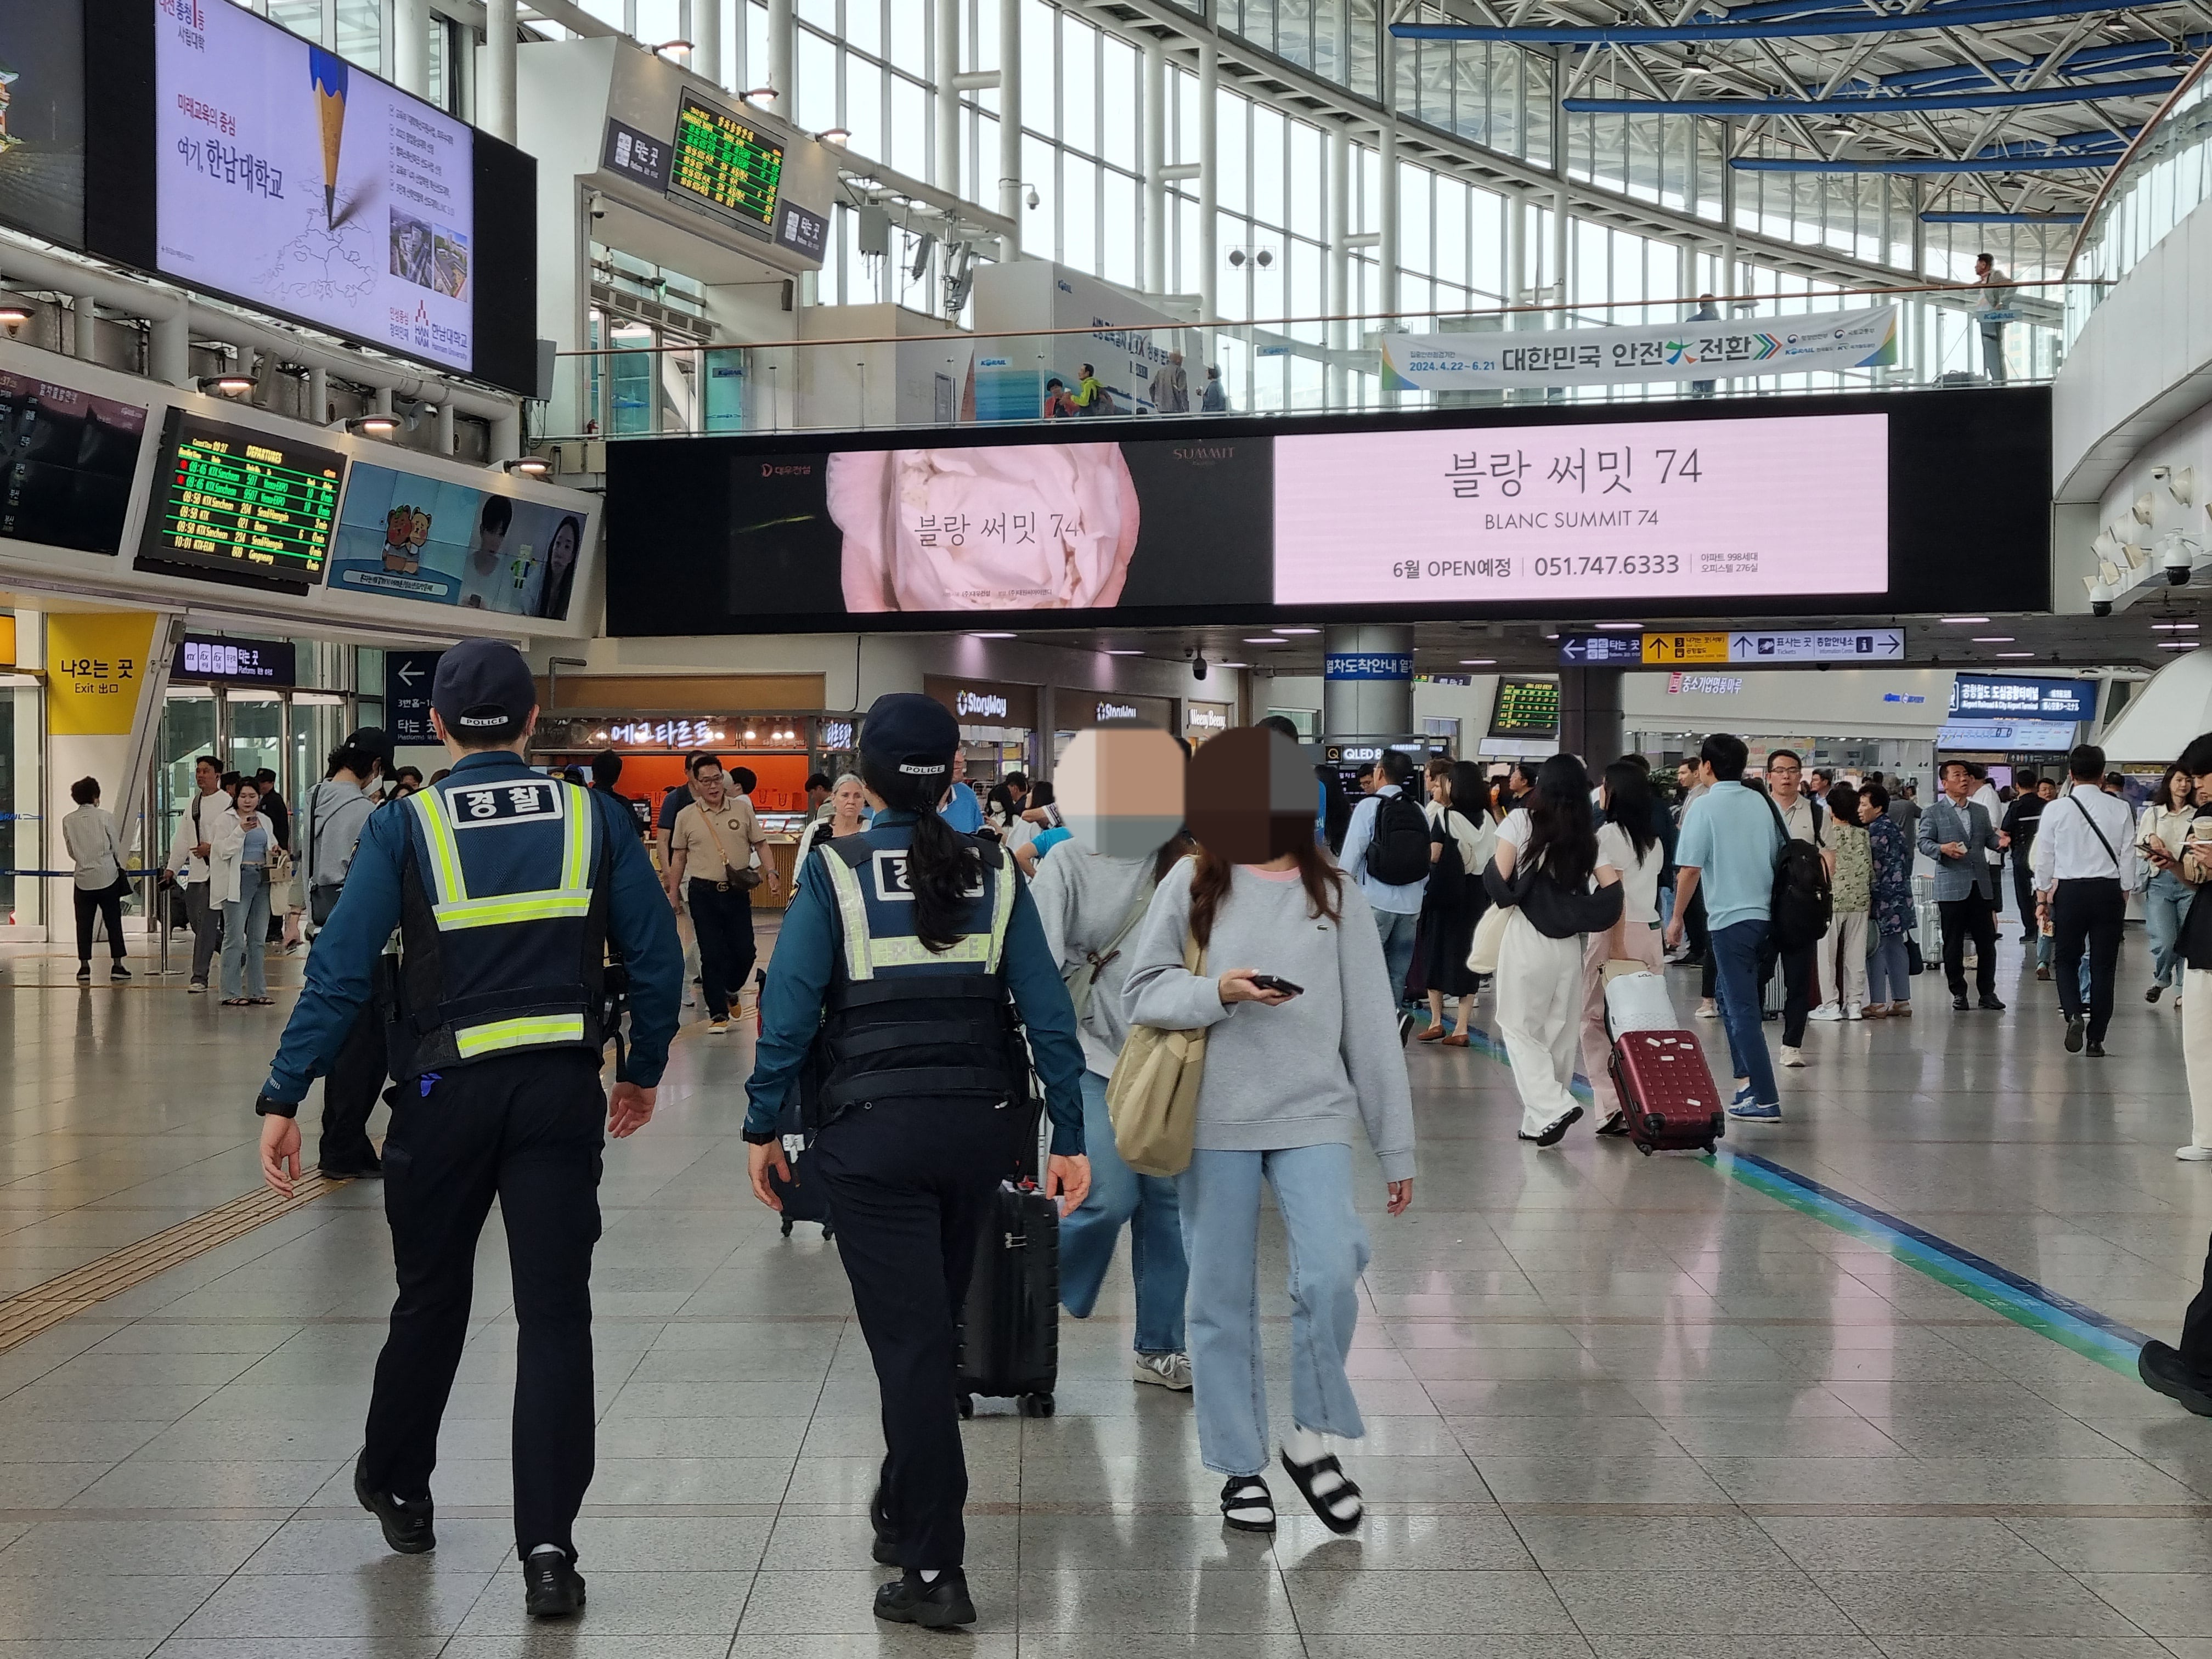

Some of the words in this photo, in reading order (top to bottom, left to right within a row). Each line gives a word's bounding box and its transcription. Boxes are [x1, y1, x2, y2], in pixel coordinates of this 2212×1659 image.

[178, 94, 218, 128] 미래교육의
[219, 111, 235, 137] 중심
[650, 147, 658, 167] 곳
[178, 137, 203, 173] 여기,
[206, 139, 284, 200] 한남대학교
[415, 325, 429, 338] HAN
[432, 323, 467, 348] 한남대학교
[1503, 345, 1601, 371] 대한민국
[1786, 347, 1815, 356] KORAIL
[246, 445, 283, 464] DEPARTURES
[1173, 447, 1235, 460] SUMMIT
[775, 465, 811, 475] 대우건설
[1444, 449, 1532, 498] 블랑
[1547, 445, 1632, 494] 써밋
[1655, 448, 1702, 484] 74
[246, 474, 258, 486] 507
[244, 489, 258, 501] 9507
[240, 503, 252, 515] 204
[237, 517, 249, 529] 021
[1485, 512, 1548, 530] BLANC
[1555, 510, 1632, 528] SUMMIT
[1638, 509, 1659, 526] 74
[914, 513, 972, 547] 블랑
[980, 511, 1035, 544] 써밋
[1050, 514, 1080, 538] 74
[234, 531, 246, 543] 234
[232, 546, 243, 558] 809
[1701, 553, 1725, 562] 아파트
[1727, 552, 1758, 561] 998세대
[1392, 559, 1420, 579] 6월
[1427, 557, 1511, 578] OPEN예정
[1534, 555, 1680, 577] 051.747.6333
[1701, 563, 1734, 573] 오피스텔
[1736, 563, 1758, 572] 276실
[1610, 640, 1627, 650] 타는
[1630, 640, 1640, 650] 곳
[1776, 637, 1801, 647] 표사는
[1803, 637, 1812, 647] 곳
[1817, 636, 1854, 647] 종합안내소
[239, 649, 250, 664] 타는
[252, 650, 258, 665] 곳
[61, 659, 109, 678] 나오는
[117, 659, 133, 679] 곳
[1327, 658, 1397, 674] 열차도착안내
[75, 683, 94, 693] Exit
[99, 684, 119, 693] 出口
[1682, 675, 1742, 695] 중소기업명품마루
[1962, 684, 1990, 699] 공항철도
[1991, 685, 2039, 701] 도심공항터미널
[968, 692, 1007, 718] StoryWay
[1962, 701, 1977, 709] Airport
[2007, 702, 2021, 710] Airport
[398, 719, 419, 732] 타는
[467, 717, 505, 725] POLICE
[1189, 709, 1209, 729] Weeny
[611, 719, 713, 748] 에그타르트
[1344, 748, 1374, 760] QLED
[906, 765, 944, 774] POLICE
[467, 787, 540, 817] 경찰
